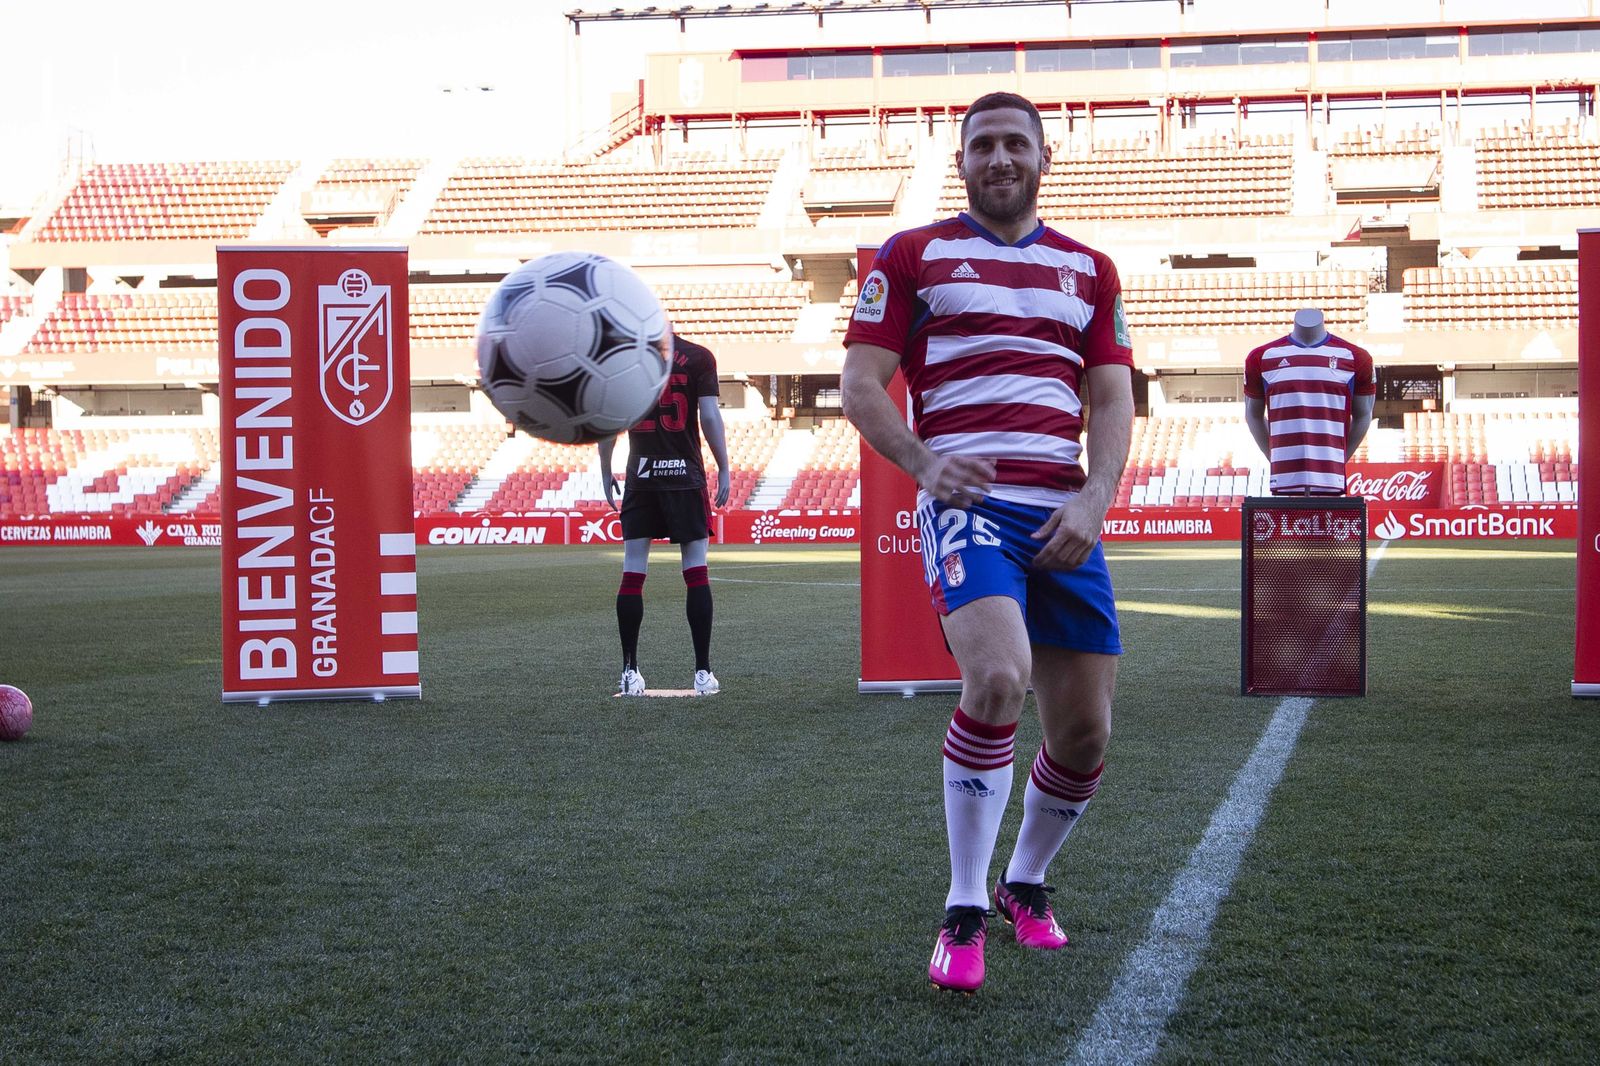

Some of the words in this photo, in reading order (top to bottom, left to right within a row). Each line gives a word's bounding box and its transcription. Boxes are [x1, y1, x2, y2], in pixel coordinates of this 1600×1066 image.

[951, 271, 980, 279] adidas
[857, 306, 882, 316] LaLiga
[631, 374, 689, 432] 5
[653, 459, 687, 468] LIDERA
[233, 268, 297, 680] BIENVENIDO
[653, 468, 687, 477] ENERGÍA
[1347, 471, 1432, 501] Coca-Cola
[167, 524, 197, 536] CAJA
[1101, 520, 1140, 534] VEZAS
[1144, 520, 1212, 534] ALHAMBRA
[1409, 513, 1554, 536] SmartBank
[0, 526, 51, 540] CERVEZAS
[54, 526, 112, 540] ALHAMBRA
[763, 525, 816, 540] Greening
[820, 526, 855, 538] Group
[938, 509, 1002, 558] 25
[878, 535, 921, 553] Club
[949, 781, 995, 797] adidas
